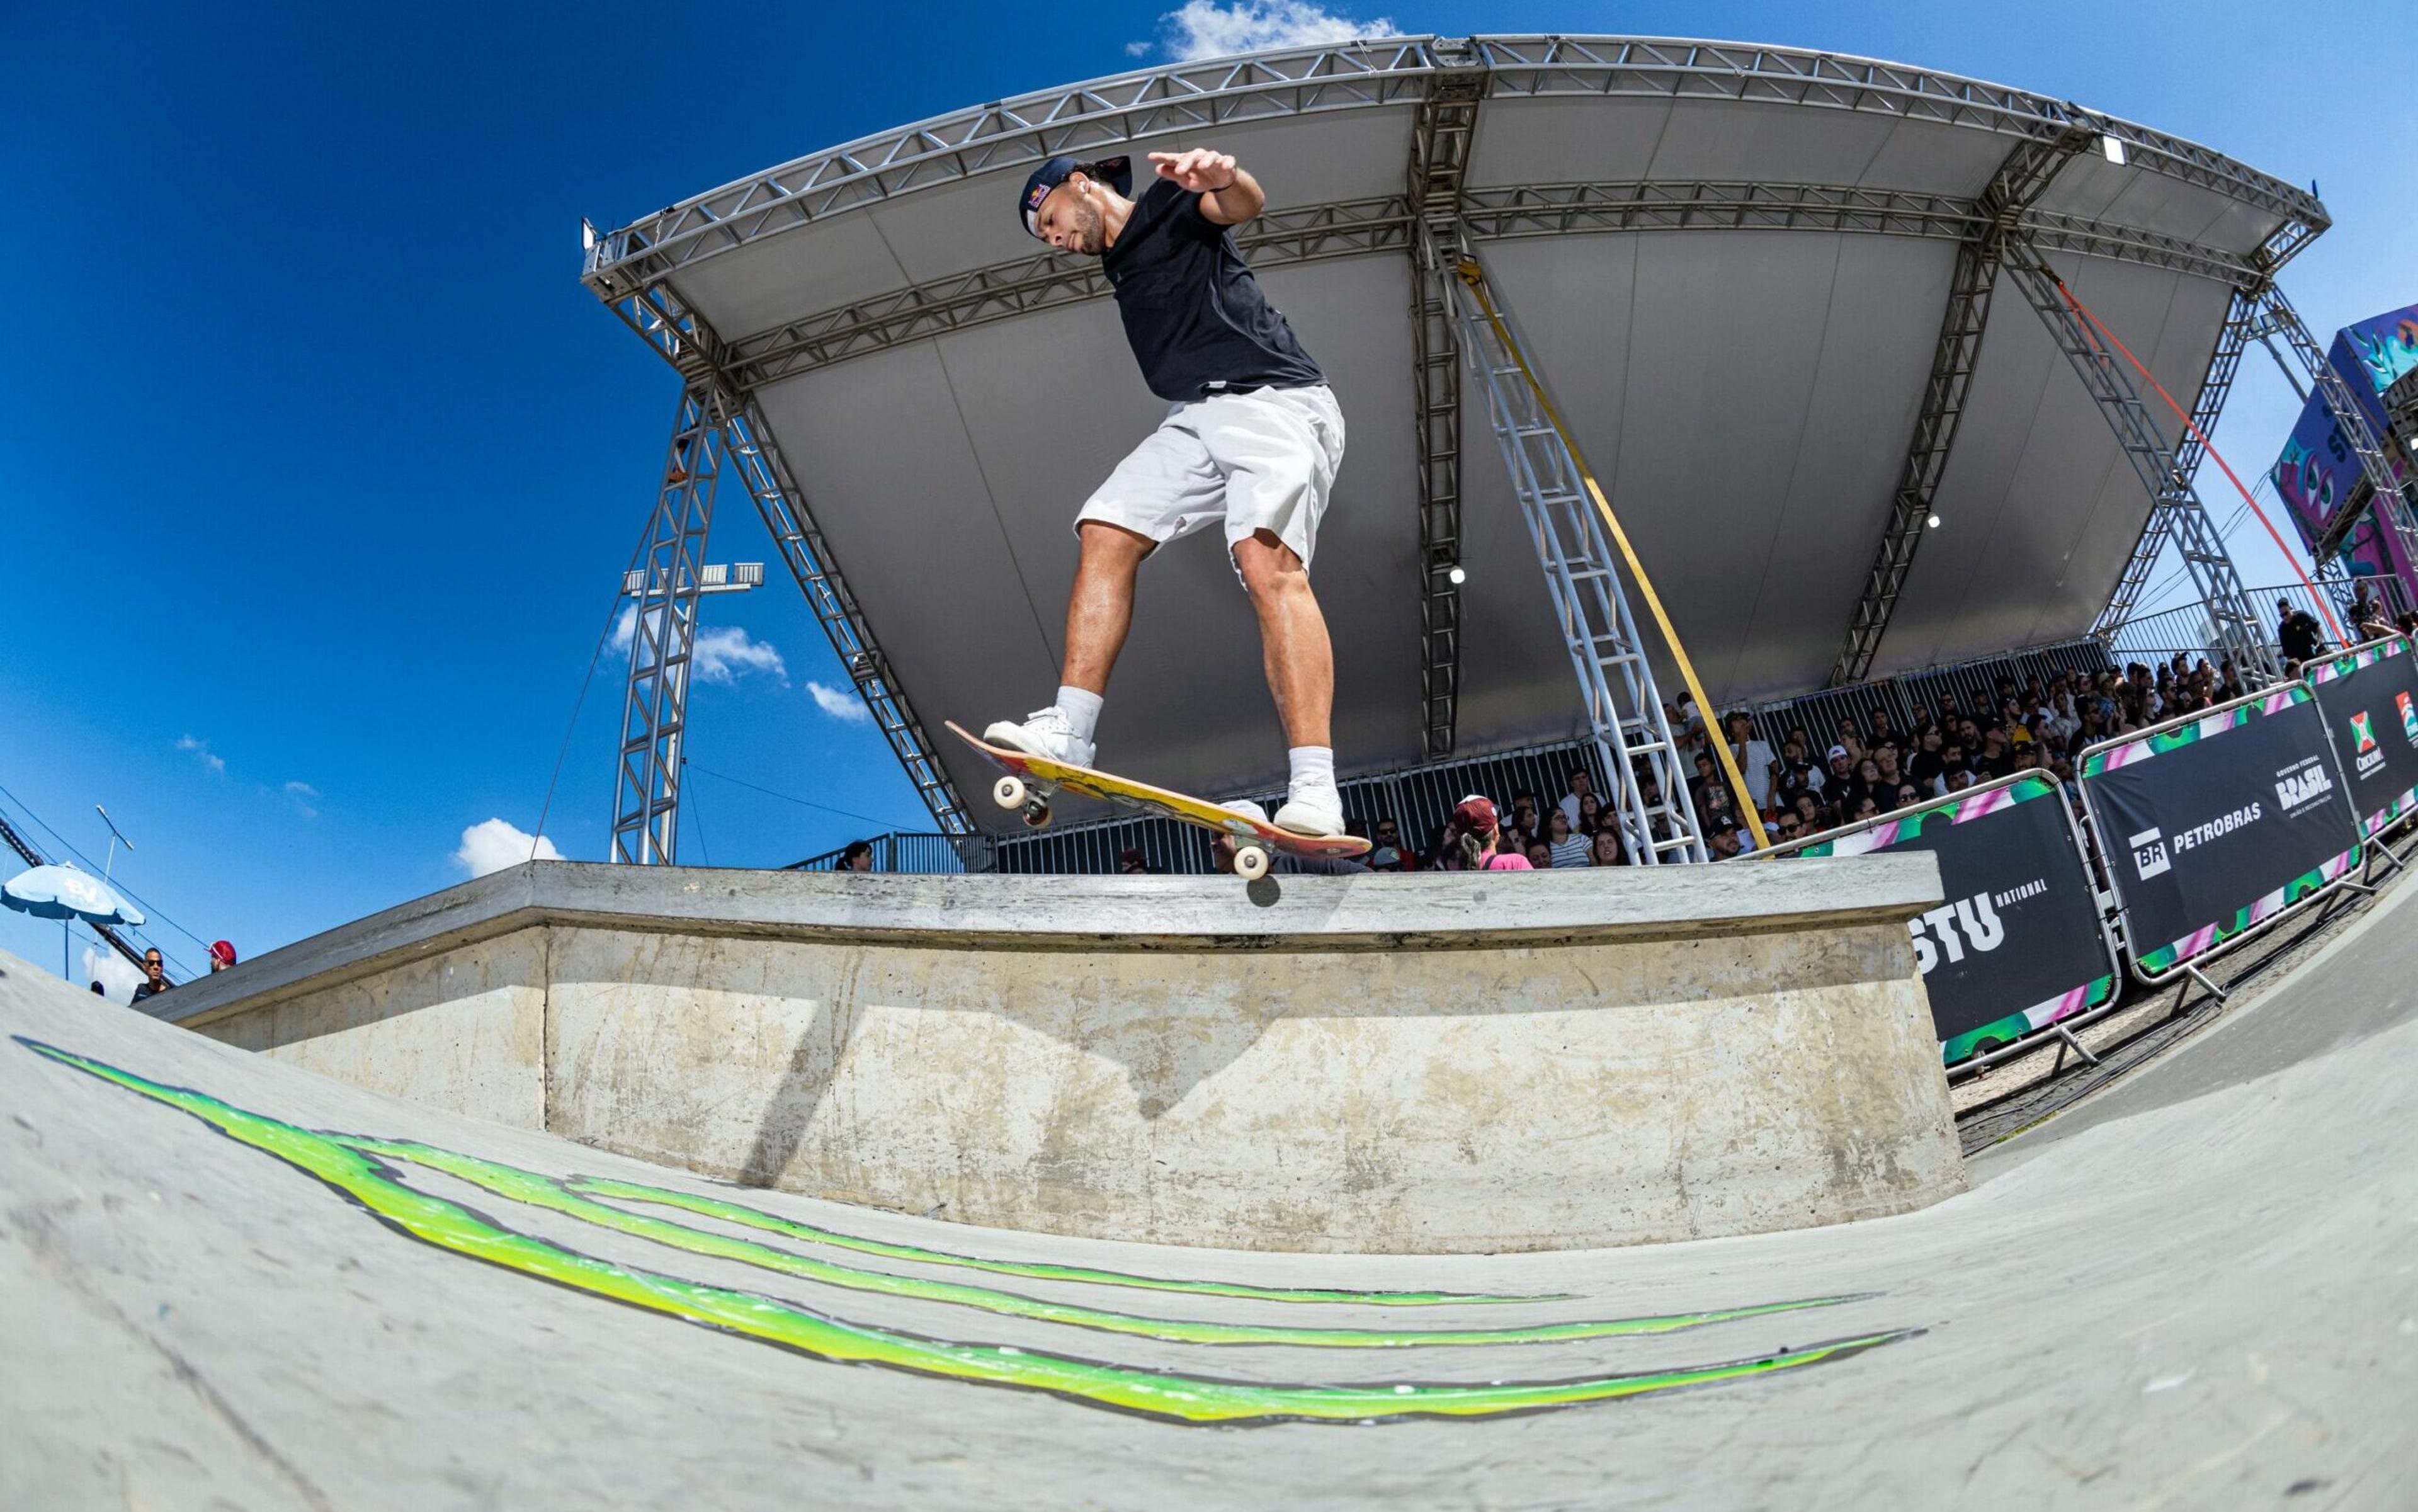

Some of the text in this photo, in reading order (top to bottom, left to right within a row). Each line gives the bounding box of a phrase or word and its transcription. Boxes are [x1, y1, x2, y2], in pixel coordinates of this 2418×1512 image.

[2275, 764, 2332, 810] BRASIL
[2174, 802, 2261, 854] PETROBRAS
[2140, 844, 2164, 868] BR
[1995, 878, 2048, 908] NATIONAL
